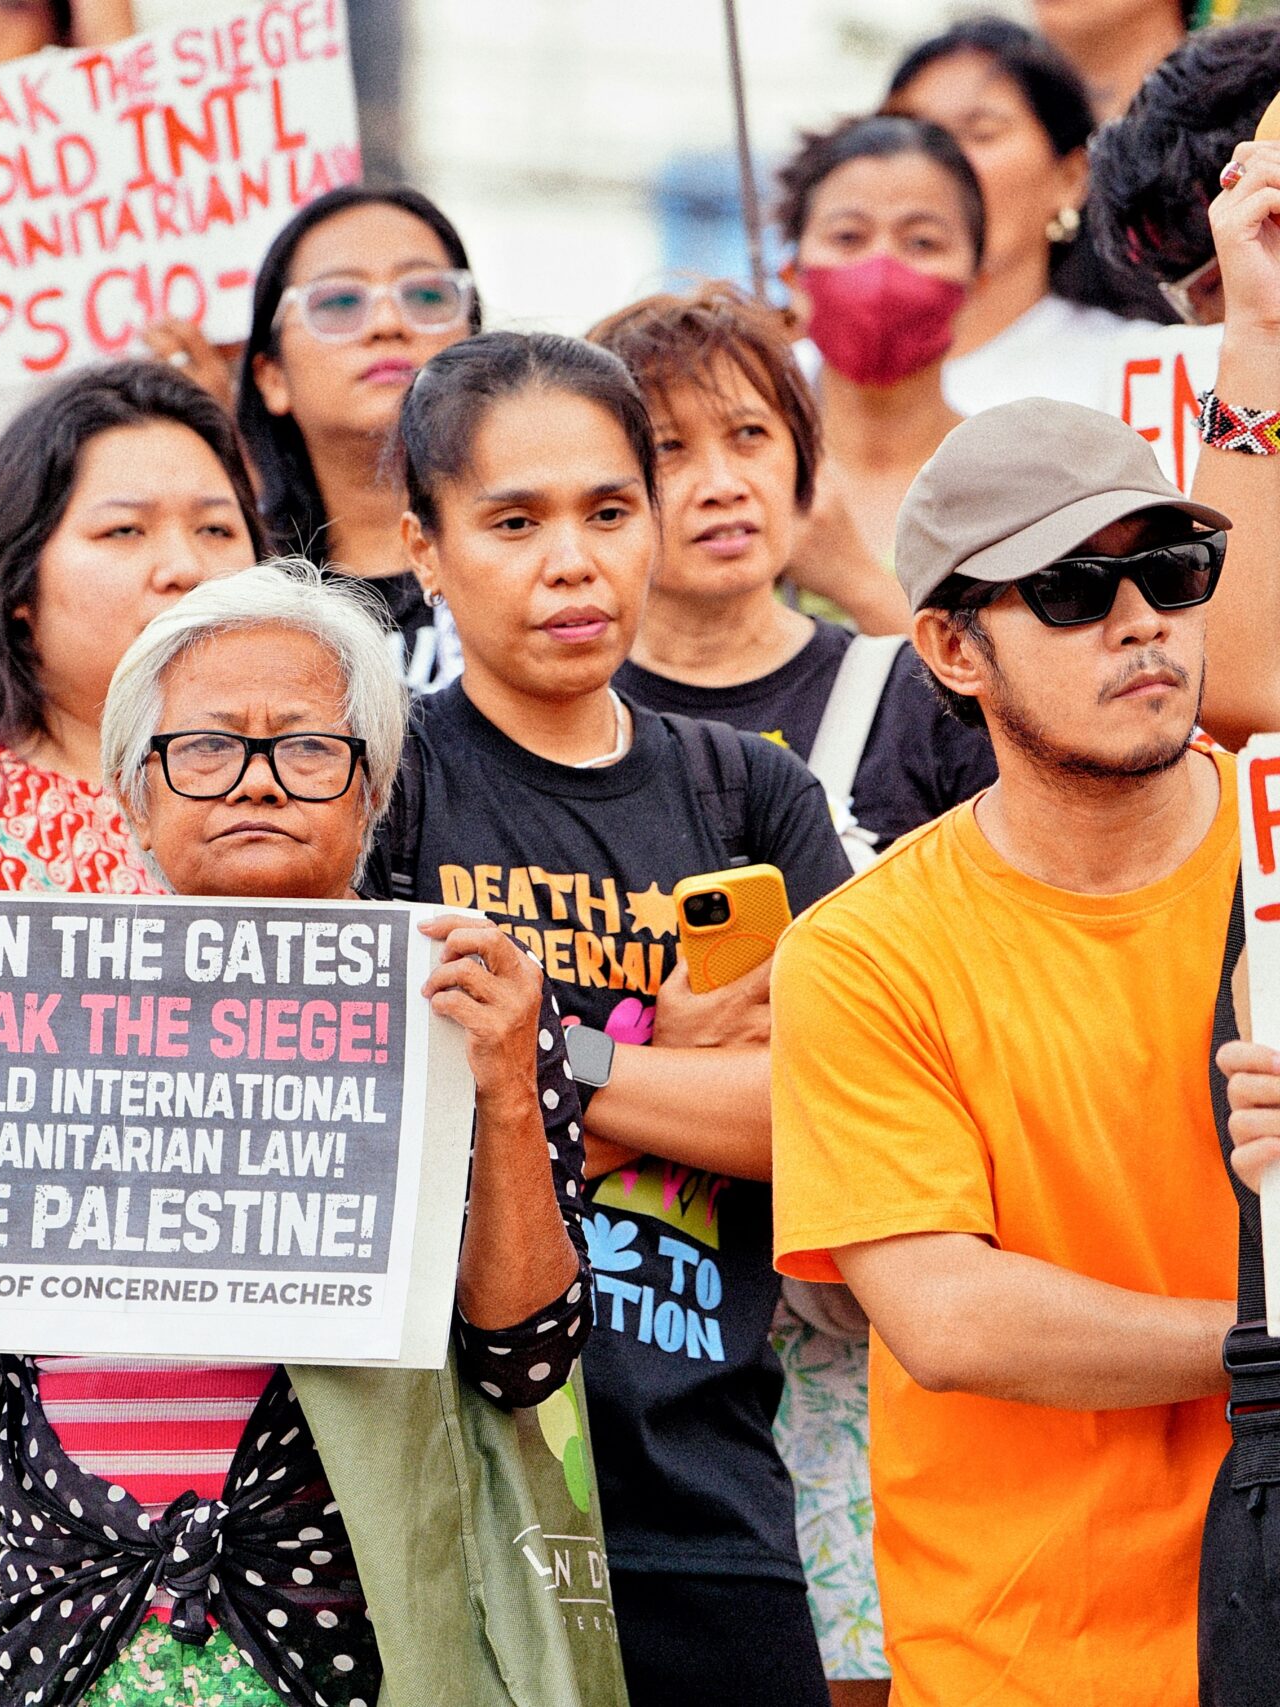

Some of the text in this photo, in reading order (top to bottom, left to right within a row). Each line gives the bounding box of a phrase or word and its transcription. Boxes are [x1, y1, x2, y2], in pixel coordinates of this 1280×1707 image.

[74, 42, 157, 112] THE
[173, 0, 340, 88] SIEGE!
[438, 864, 621, 933] DEATH
[51, 917, 167, 981] THE
[184, 920, 393, 988] GATES!
[80, 994, 193, 1058] THE
[209, 998, 389, 1064] SIEGE!
[51, 1067, 387, 1124] INTERNATIONAL
[238, 1129, 348, 1179] LAW!
[31, 1183, 378, 1260] PALESTINE!
[39, 1275, 219, 1304] CONCERNED
[226, 1281, 374, 1308] TEACHERS
[658, 1235, 723, 1310] TO
[591, 1273, 726, 1362] TION
